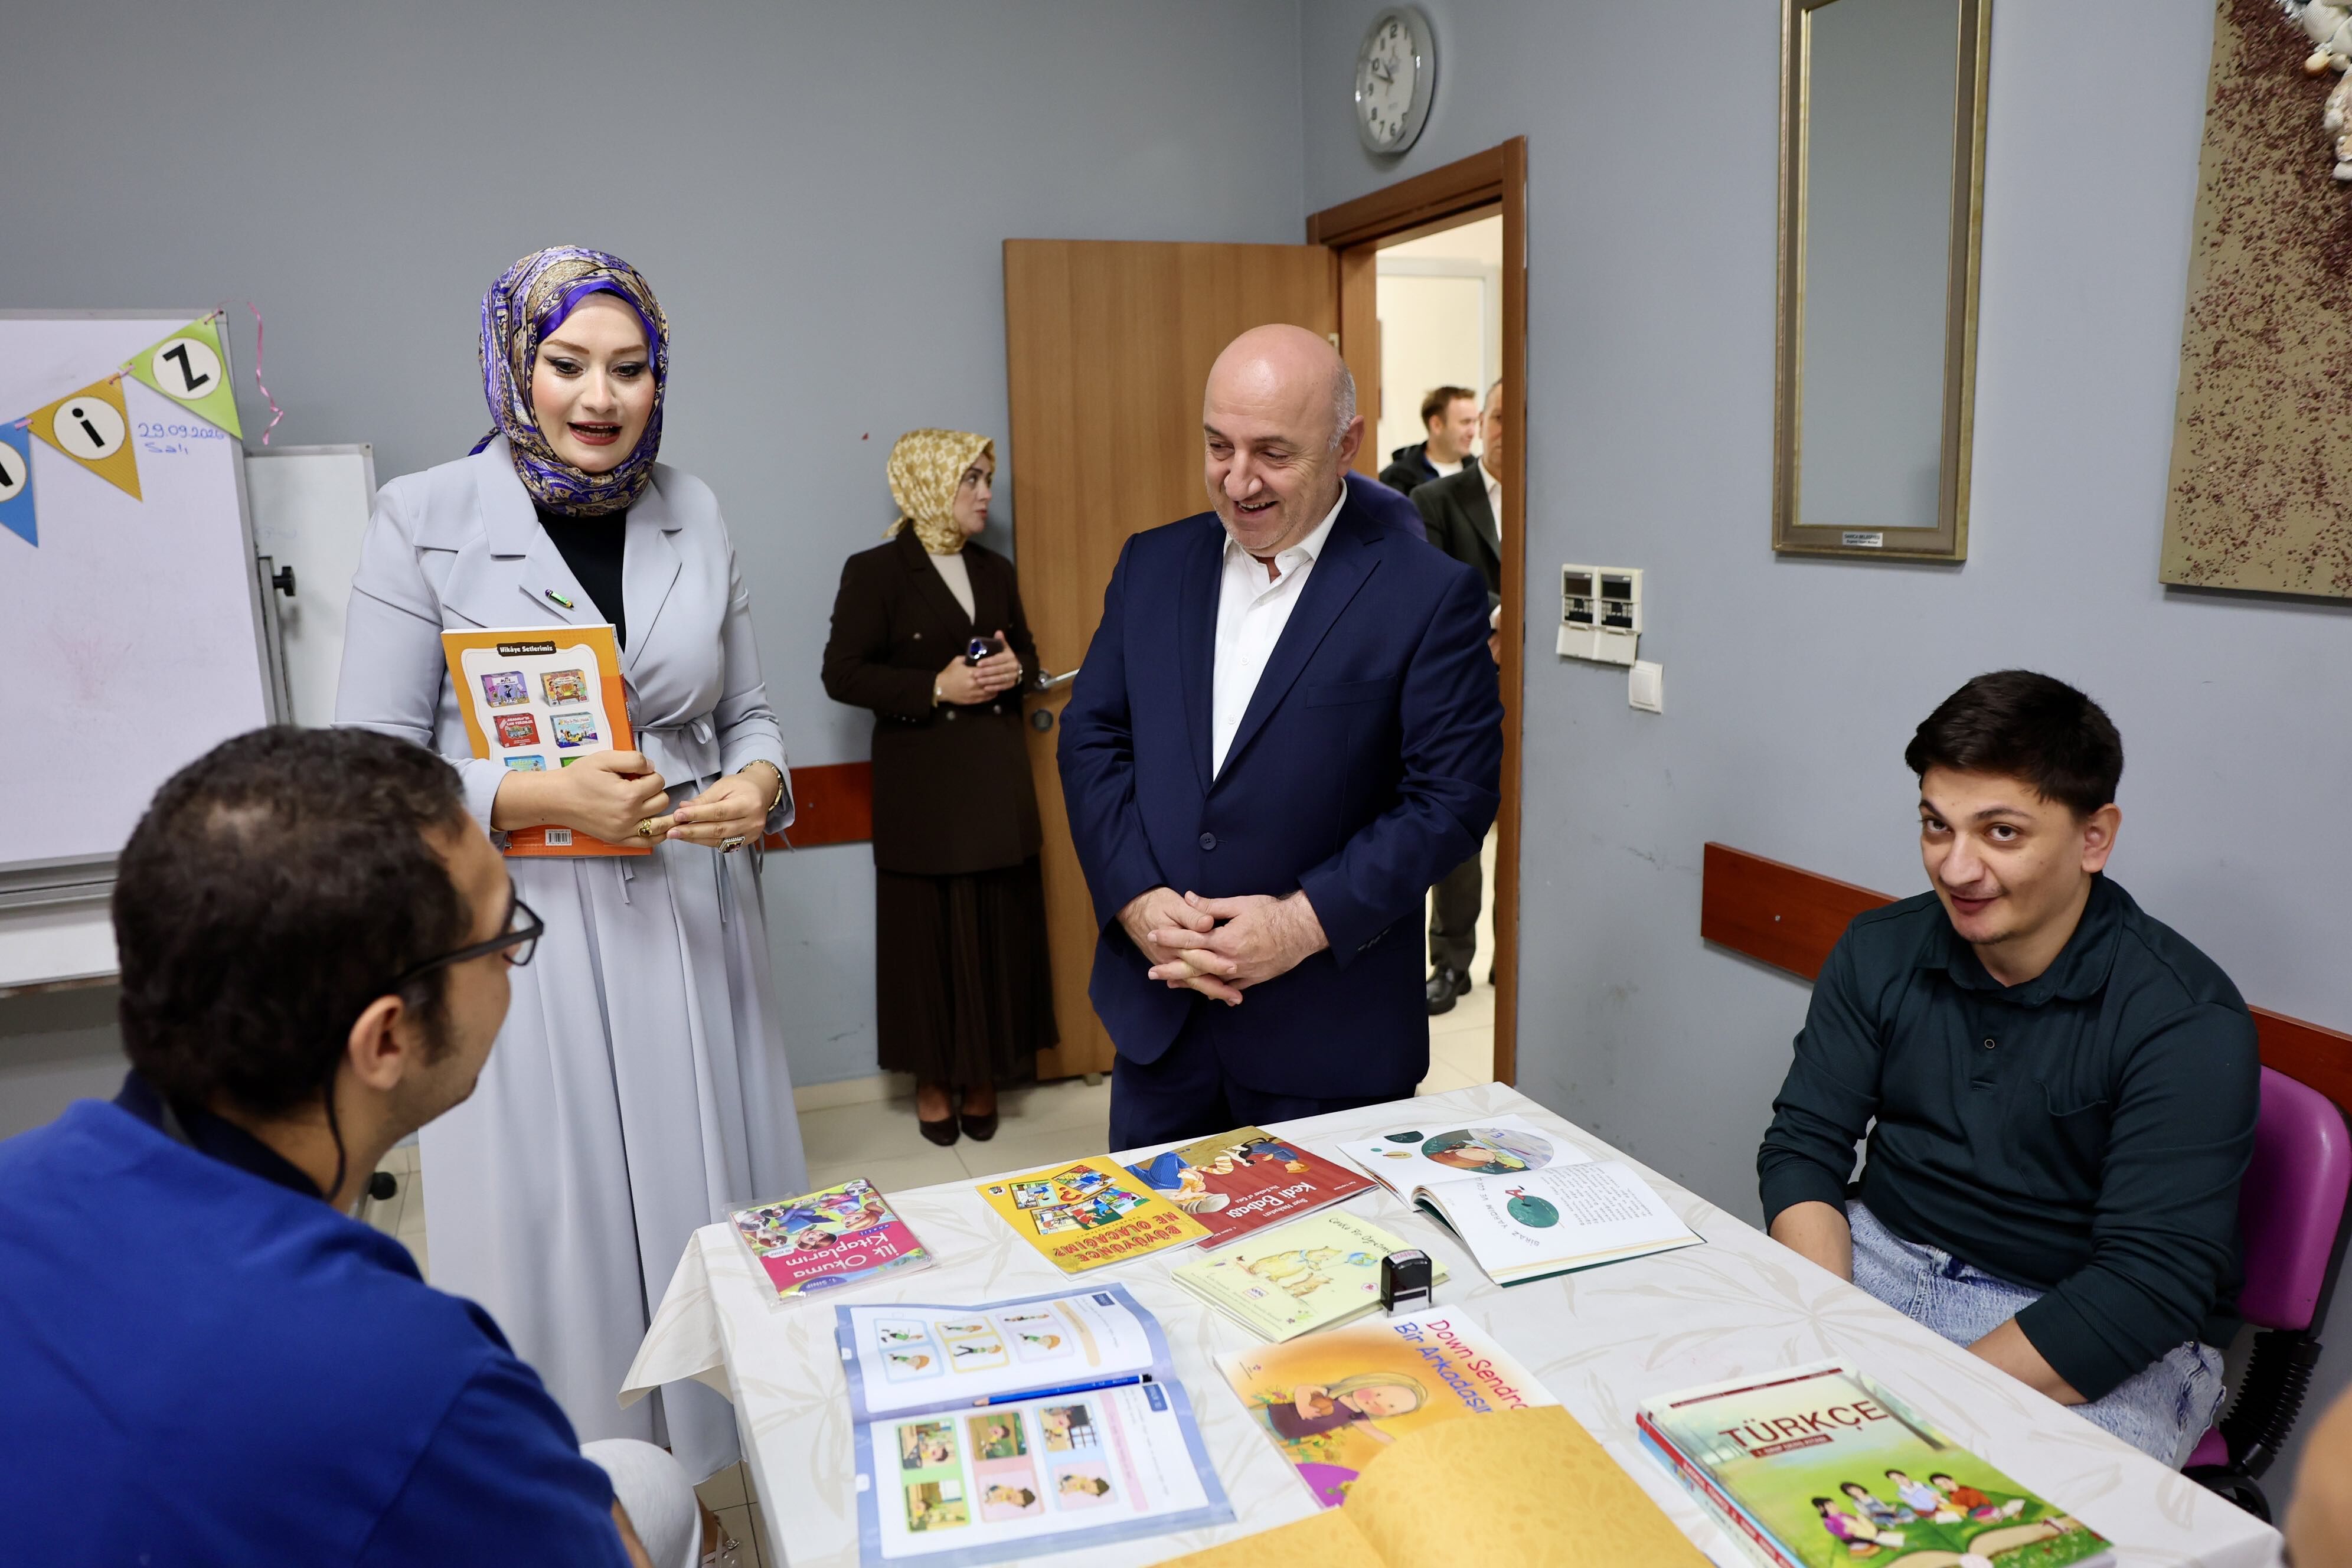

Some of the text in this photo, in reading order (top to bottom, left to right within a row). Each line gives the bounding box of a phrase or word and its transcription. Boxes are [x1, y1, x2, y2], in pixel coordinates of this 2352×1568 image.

[500, 645, 553, 654] Hikâye Setlerimiz
[1279, 1181, 1318, 1200] Kedi
[1225, 1194, 1285, 1219] Babası
[785, 1231, 889, 1266] Kitaplarım
[1054, 1211, 1180, 1257] NE OLACAĞIM?
[1077, 1226, 1182, 1263] BÜYÜYÜNCE
[793, 1253, 867, 1279] Okuma
[1394, 1322, 1425, 1344] Bir
[1426, 1319, 1474, 1360] Down
[1718, 1400, 1891, 1452] TÜRKÇE
